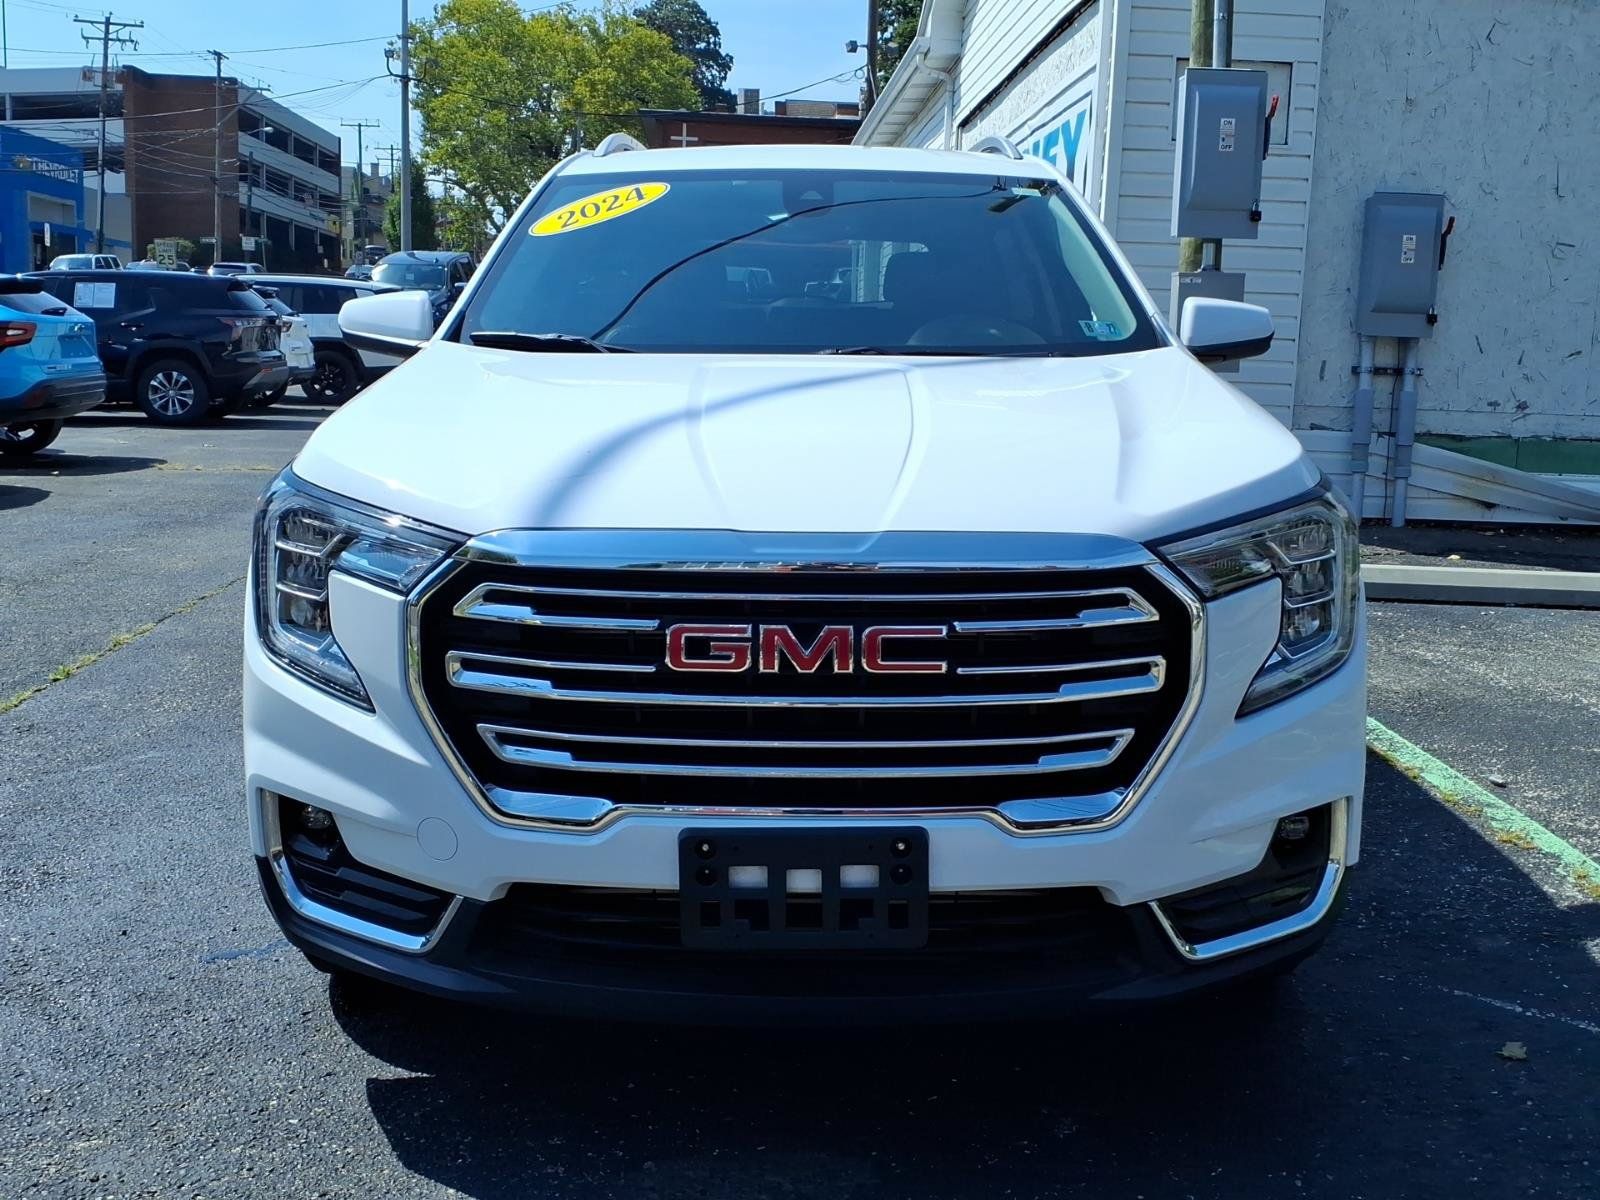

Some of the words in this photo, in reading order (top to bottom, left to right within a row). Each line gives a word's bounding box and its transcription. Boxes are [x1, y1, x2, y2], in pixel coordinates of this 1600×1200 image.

[1023, 109, 1087, 184] EY
[32, 157, 79, 184] CHEVROLET
[557, 187, 648, 229] 2024
[158, 254, 175, 265] 25
[665, 623, 948, 674] GMC
